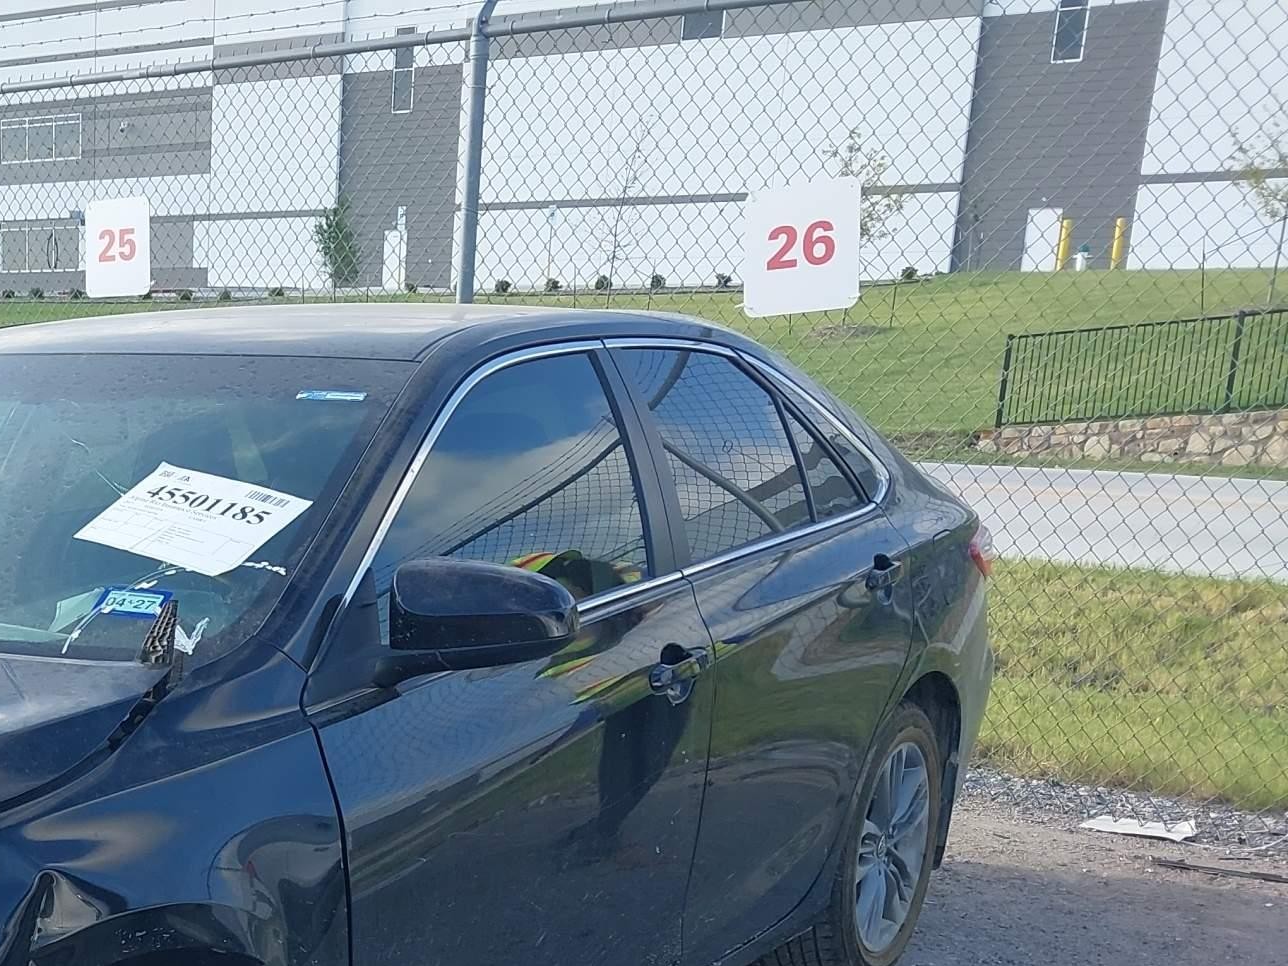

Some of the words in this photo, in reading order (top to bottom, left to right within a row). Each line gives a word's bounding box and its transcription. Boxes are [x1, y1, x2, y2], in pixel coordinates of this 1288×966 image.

[98, 228, 136, 262] 25
[767, 220, 835, 270] 26
[146, 485, 272, 525] 45501185
